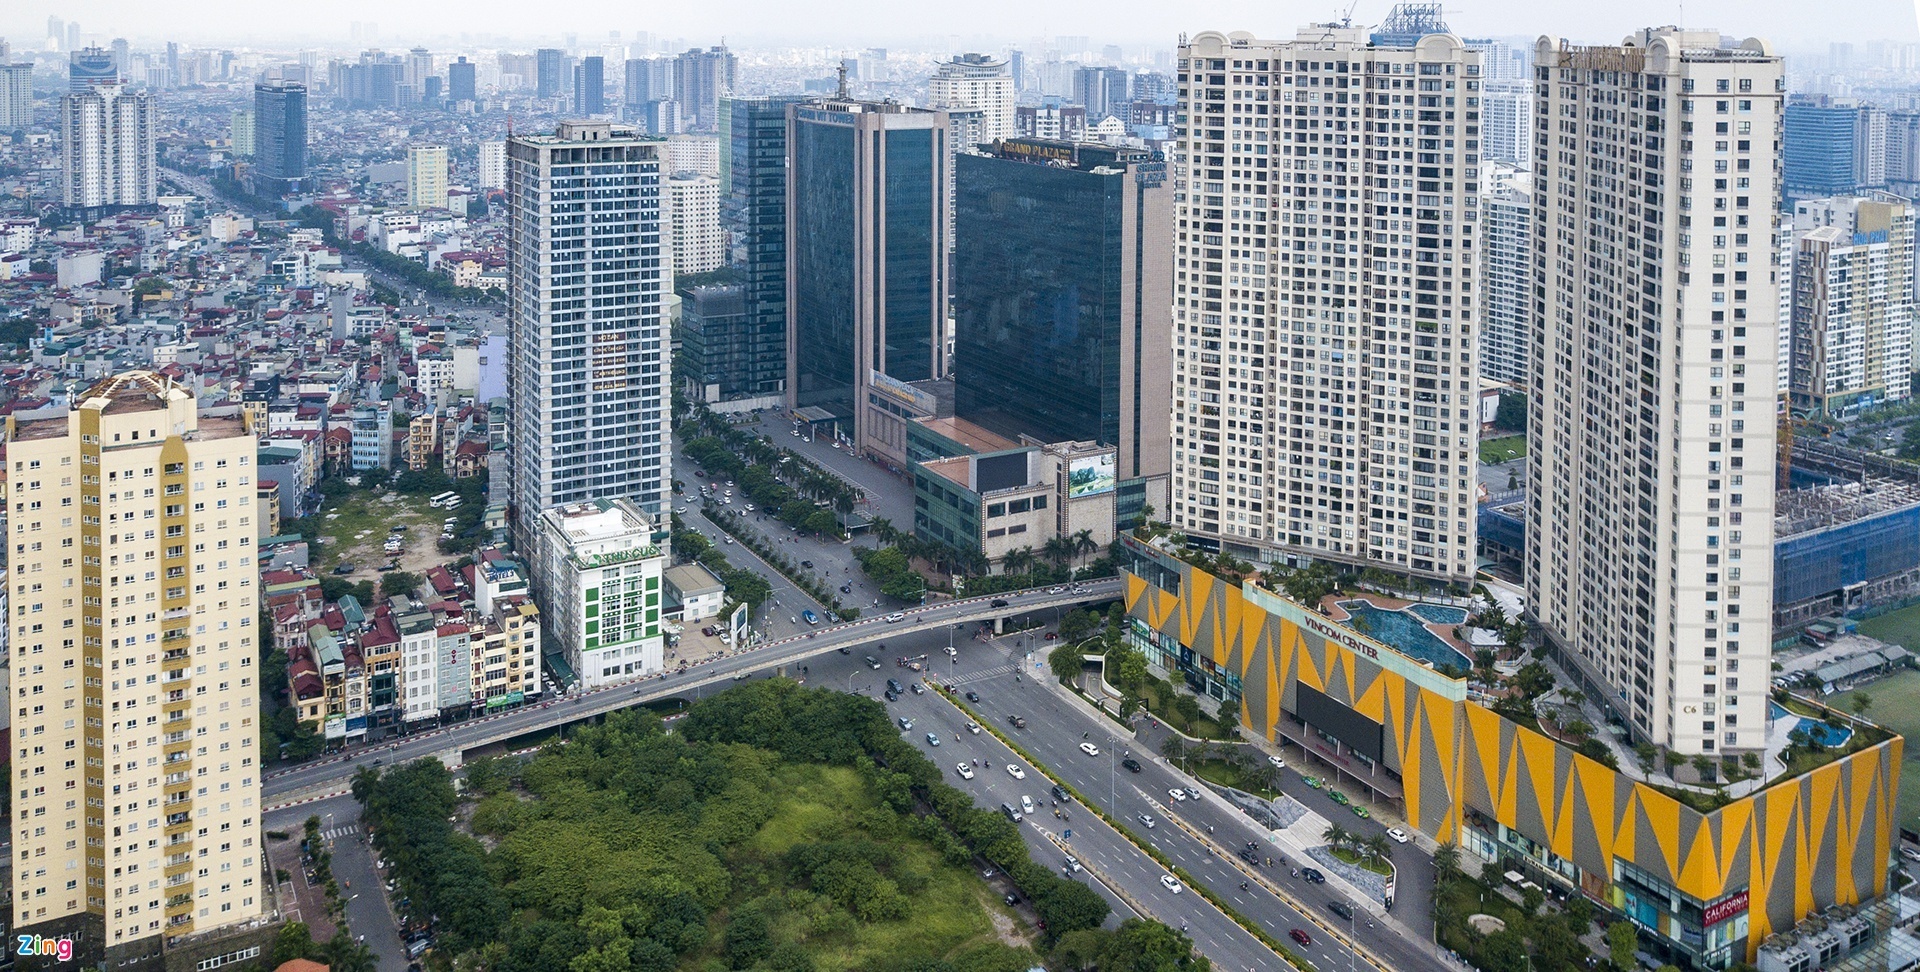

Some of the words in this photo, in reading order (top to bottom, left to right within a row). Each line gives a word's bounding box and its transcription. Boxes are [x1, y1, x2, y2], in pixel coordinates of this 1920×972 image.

[1004, 142, 1031, 156] GRAND
[1032, 145, 1060, 160] PLAZA
[1135, 172, 1167, 183] PLAZA
[1304, 615, 1342, 643] VINCOM
[1342, 635, 1379, 661] CENTER
[1683, 705, 1697, 714] C6
[1705, 894, 1748, 920] CALIFORNIA
